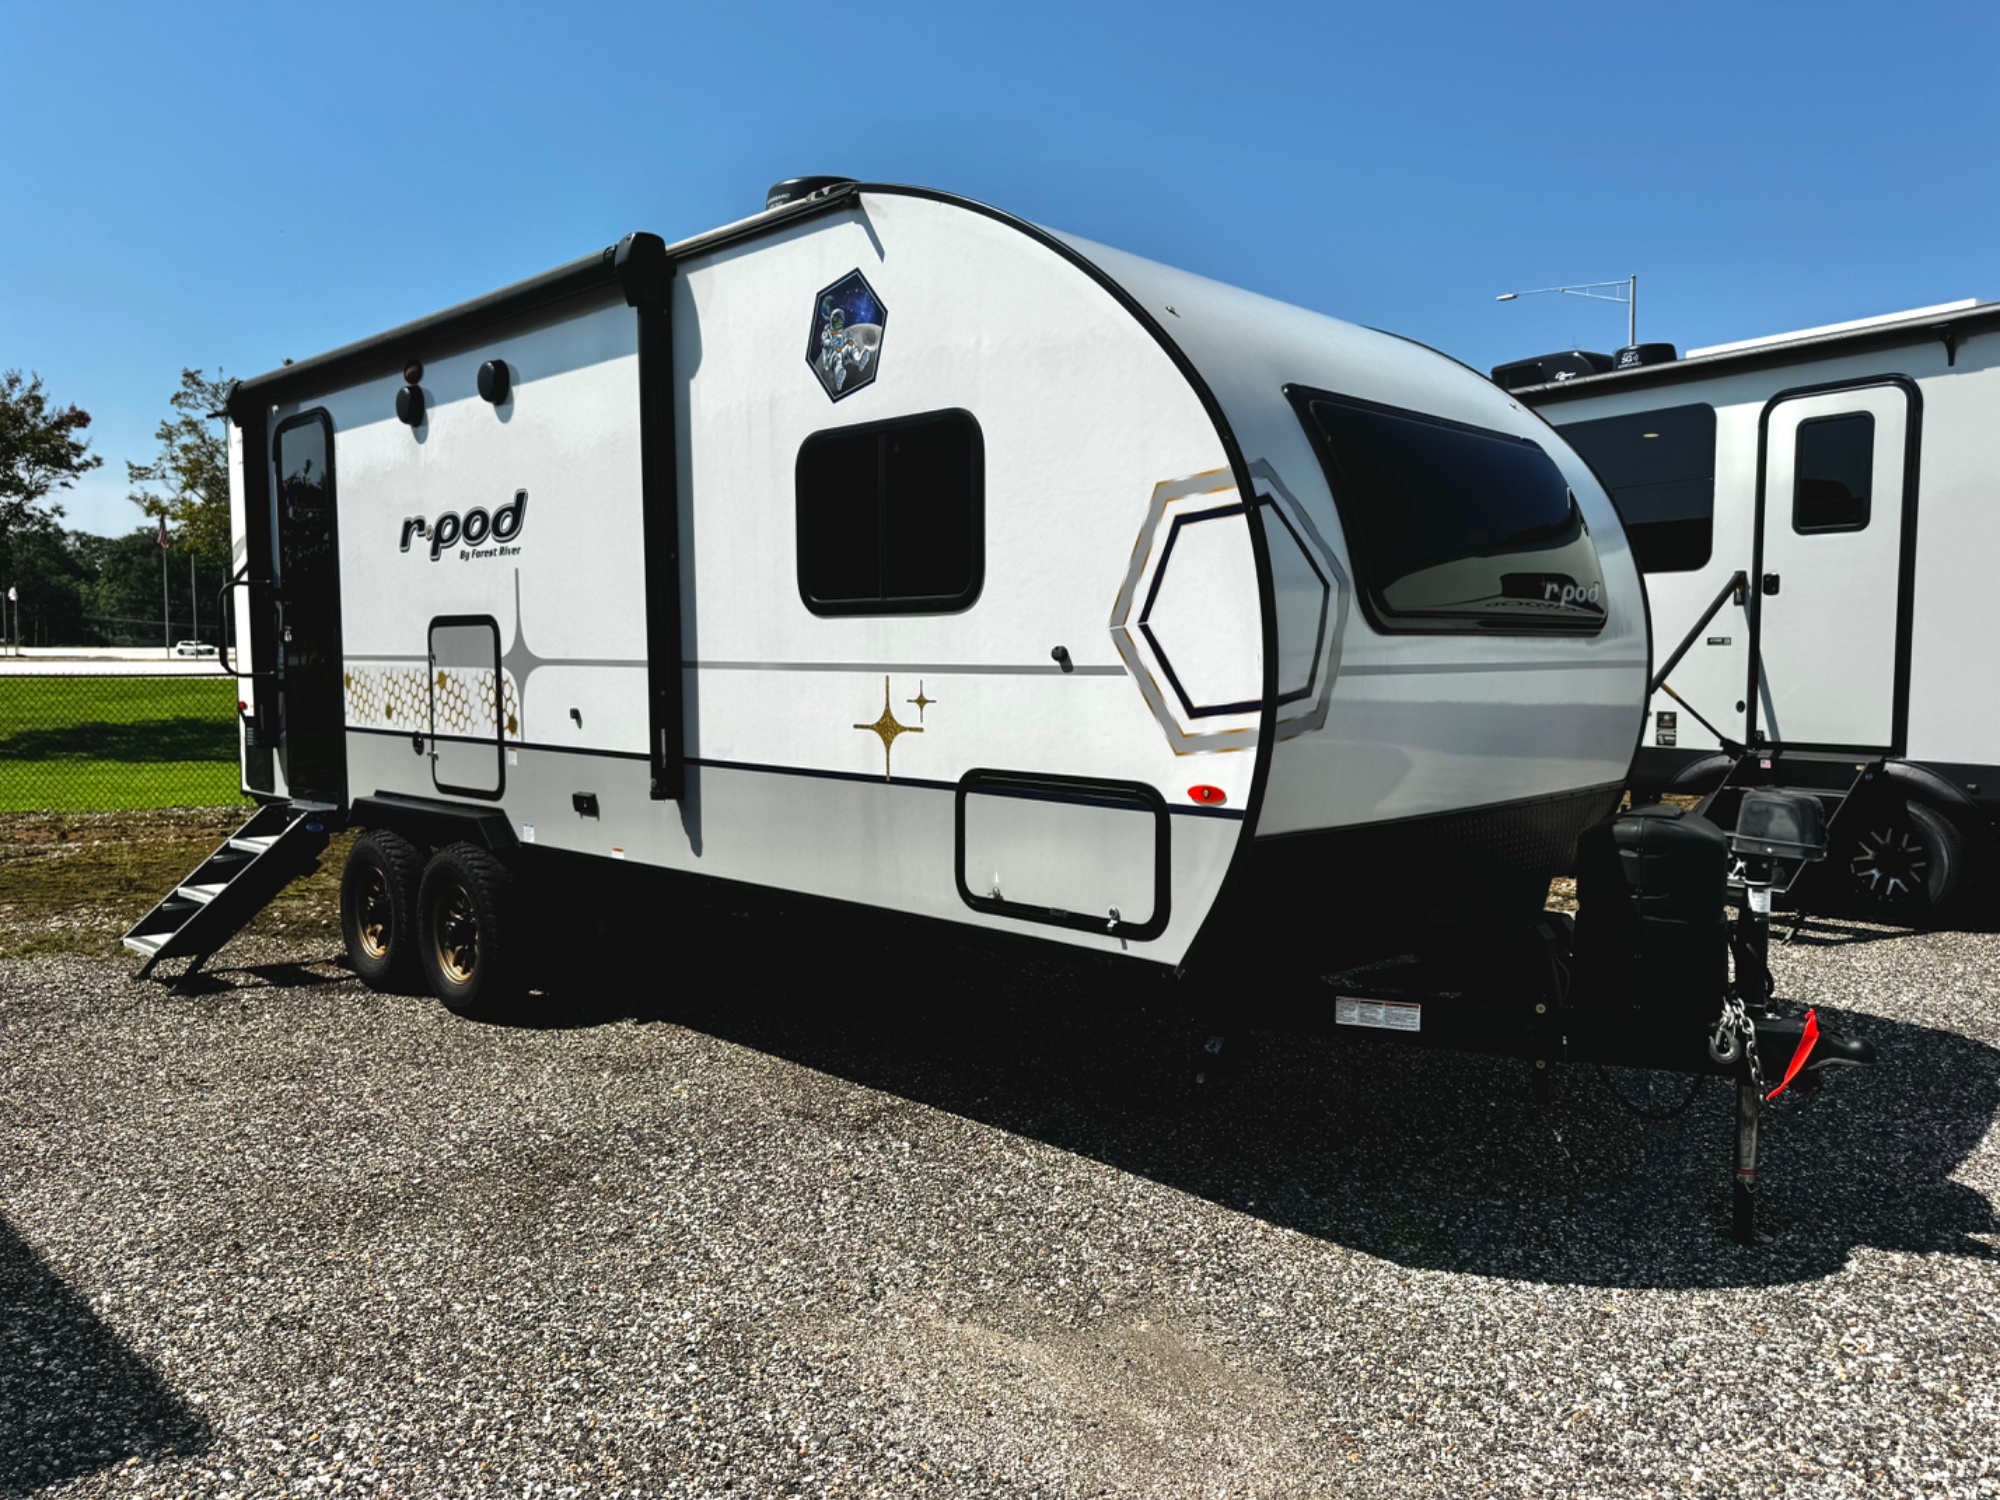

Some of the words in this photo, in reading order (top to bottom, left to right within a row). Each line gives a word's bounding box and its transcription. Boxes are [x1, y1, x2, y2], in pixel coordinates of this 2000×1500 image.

[460, 550, 470, 562] By
[471, 548, 498, 559] Forest
[499, 545, 521, 556] River
